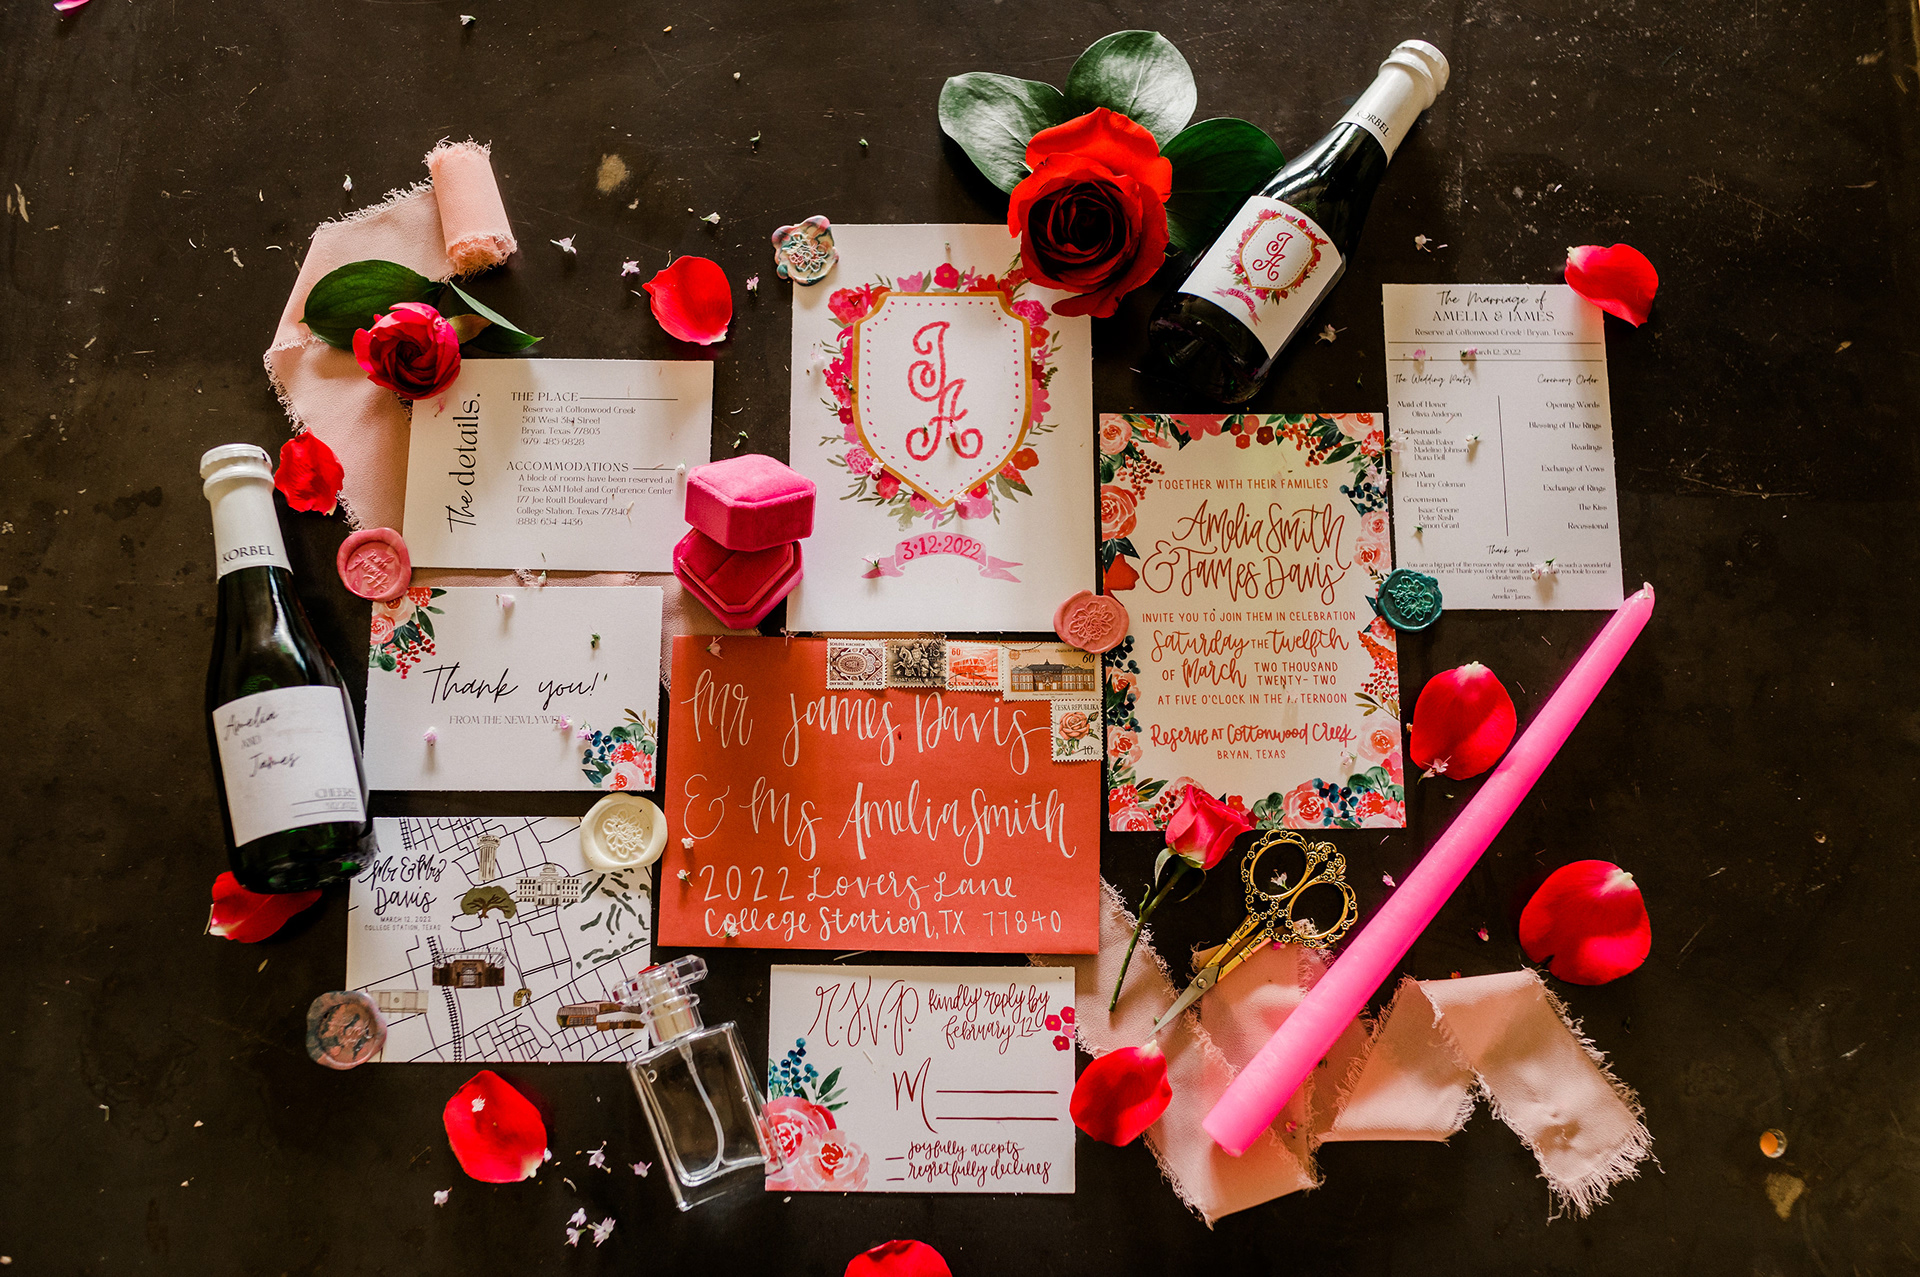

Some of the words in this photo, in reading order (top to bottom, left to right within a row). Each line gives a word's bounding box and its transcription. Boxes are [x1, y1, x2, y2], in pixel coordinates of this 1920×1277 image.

[1437, 290, 1460, 306] The
[1466, 290, 1529, 312] Marriage
[1535, 290, 1547, 310] of
[1432, 311, 1489, 322] AMELIA
[1494, 311, 1503, 322] &
[1508, 311, 1555, 322] JAMES
[1414, 328, 1444, 336] Reserve
[1393, 374, 1407, 383] The
[1411, 374, 1445, 387] Wedding
[1449, 374, 1472, 385] Party
[1576, 374, 1598, 385] Order
[511, 392, 534, 401] THE
[538, 392, 579, 402] PLACE
[522, 405, 553, 413] Reserve
[555, 406, 563, 414] at
[565, 405, 611, 414] Cottonwood
[613, 405, 636, 414] Creek
[538, 416, 559, 424] West
[577, 416, 600, 424] Street
[549, 427, 571, 435] Texas
[448, 393, 481, 486] details.
[506, 461, 629, 472] ACCOMMODATIONS
[526, 474, 547, 482] block
[549, 474, 557, 482] of
[587, 475, 606, 483] have
[608, 475, 627, 483] been
[628, 475, 663, 484] reserved
[1158, 479, 1212, 490] TOGETHER
[1215, 478, 1243, 489] WITH
[1246, 478, 1277, 489] THEIR
[1280, 478, 1329, 489] FAMILIES
[518, 485, 540, 493] Texas
[542, 485, 561, 493] A&M
[563, 485, 583, 493] Hotel
[601, 486, 646, 494] Conference
[531, 496, 544, 504] Joe
[568, 496, 608, 504] Boulevard
[445, 490, 477, 533] The
[516, 507, 543, 515] College
[577, 507, 599, 515] Texas
[1172, 499, 1264, 553] Amelia
[1265, 502, 1352, 571] Smith
[222, 545, 274, 563] KORBEL
[1487, 544, 1510, 555] Thank
[1142, 540, 1180, 593] &
[1171, 546, 1262, 602] James
[1263, 555, 1346, 605] Davis
[1142, 612, 1174, 622] INVITE
[1178, 612, 1199, 622] YOU
[1203, 612, 1216, 622] TO
[1219, 612, 1242, 622] JOIN
[1246, 612, 1273, 621] THEM
[1276, 611, 1286, 621] IN
[1289, 611, 1356, 621] CELEBRATION
[1151, 629, 1250, 662] Saturday
[1251, 638, 1269, 649] THE
[951, 648, 961, 656] 60
[1082, 653, 1096, 663] 60
[1254, 662, 1277, 672] TWO
[1282, 661, 1338, 672] THOUSAND
[1162, 669, 1175, 681] OF
[1181, 658, 1247, 688] March
[1313, 674, 1337, 685] TWO
[423, 662, 519, 704] Thank
[538, 672, 600, 711] you!
[1158, 695, 1170, 705] AT
[1175, 694, 1197, 705] FIVE
[1201, 694, 1245, 705] O'CLOCK
[1250, 694, 1260, 704] IN
[1264, 694, 1282, 704] THE
[449, 715, 480, 725] FROM
[482, 715, 501, 725] THE
[681, 668, 754, 749] Mr
[782, 693, 900, 767] James
[916, 692, 1050, 775] Davis
[1150, 723, 1209, 752] Reserve
[1211, 728, 1224, 740] AT
[1227, 723, 1308, 745] Cottonwood
[1312, 722, 1358, 748] Creek
[1217, 750, 1253, 760] BRYAN,
[1256, 749, 1286, 759] TEXAS
[683, 773, 730, 840] &
[740, 775, 823, 862] Ms
[838, 779, 966, 860] Amelia
[962, 788, 1077, 867] Smith
[358, 855, 399, 891] Mr
[400, 856, 417, 883] &
[416, 853, 447, 883] Mrs
[699, 865, 795, 903] 2022
[806, 866, 930, 911] Lovers
[934, 871, 1017, 903] Lane
[373, 886, 438, 916] Davis
[704, 907, 811, 942] College
[982, 908, 1062, 934] 77840
[928, 984, 982, 1022] kindly
[983, 982, 1026, 1024] reply
[1026, 985, 1050, 1025] by
[1016, 1016, 1042, 1038] 12
[908, 1140, 967, 1164] joyfully
[971, 1140, 1025, 1162] accepts
[907, 1161, 988, 1187] regretfully
[990, 1161, 1052, 1185] declines
